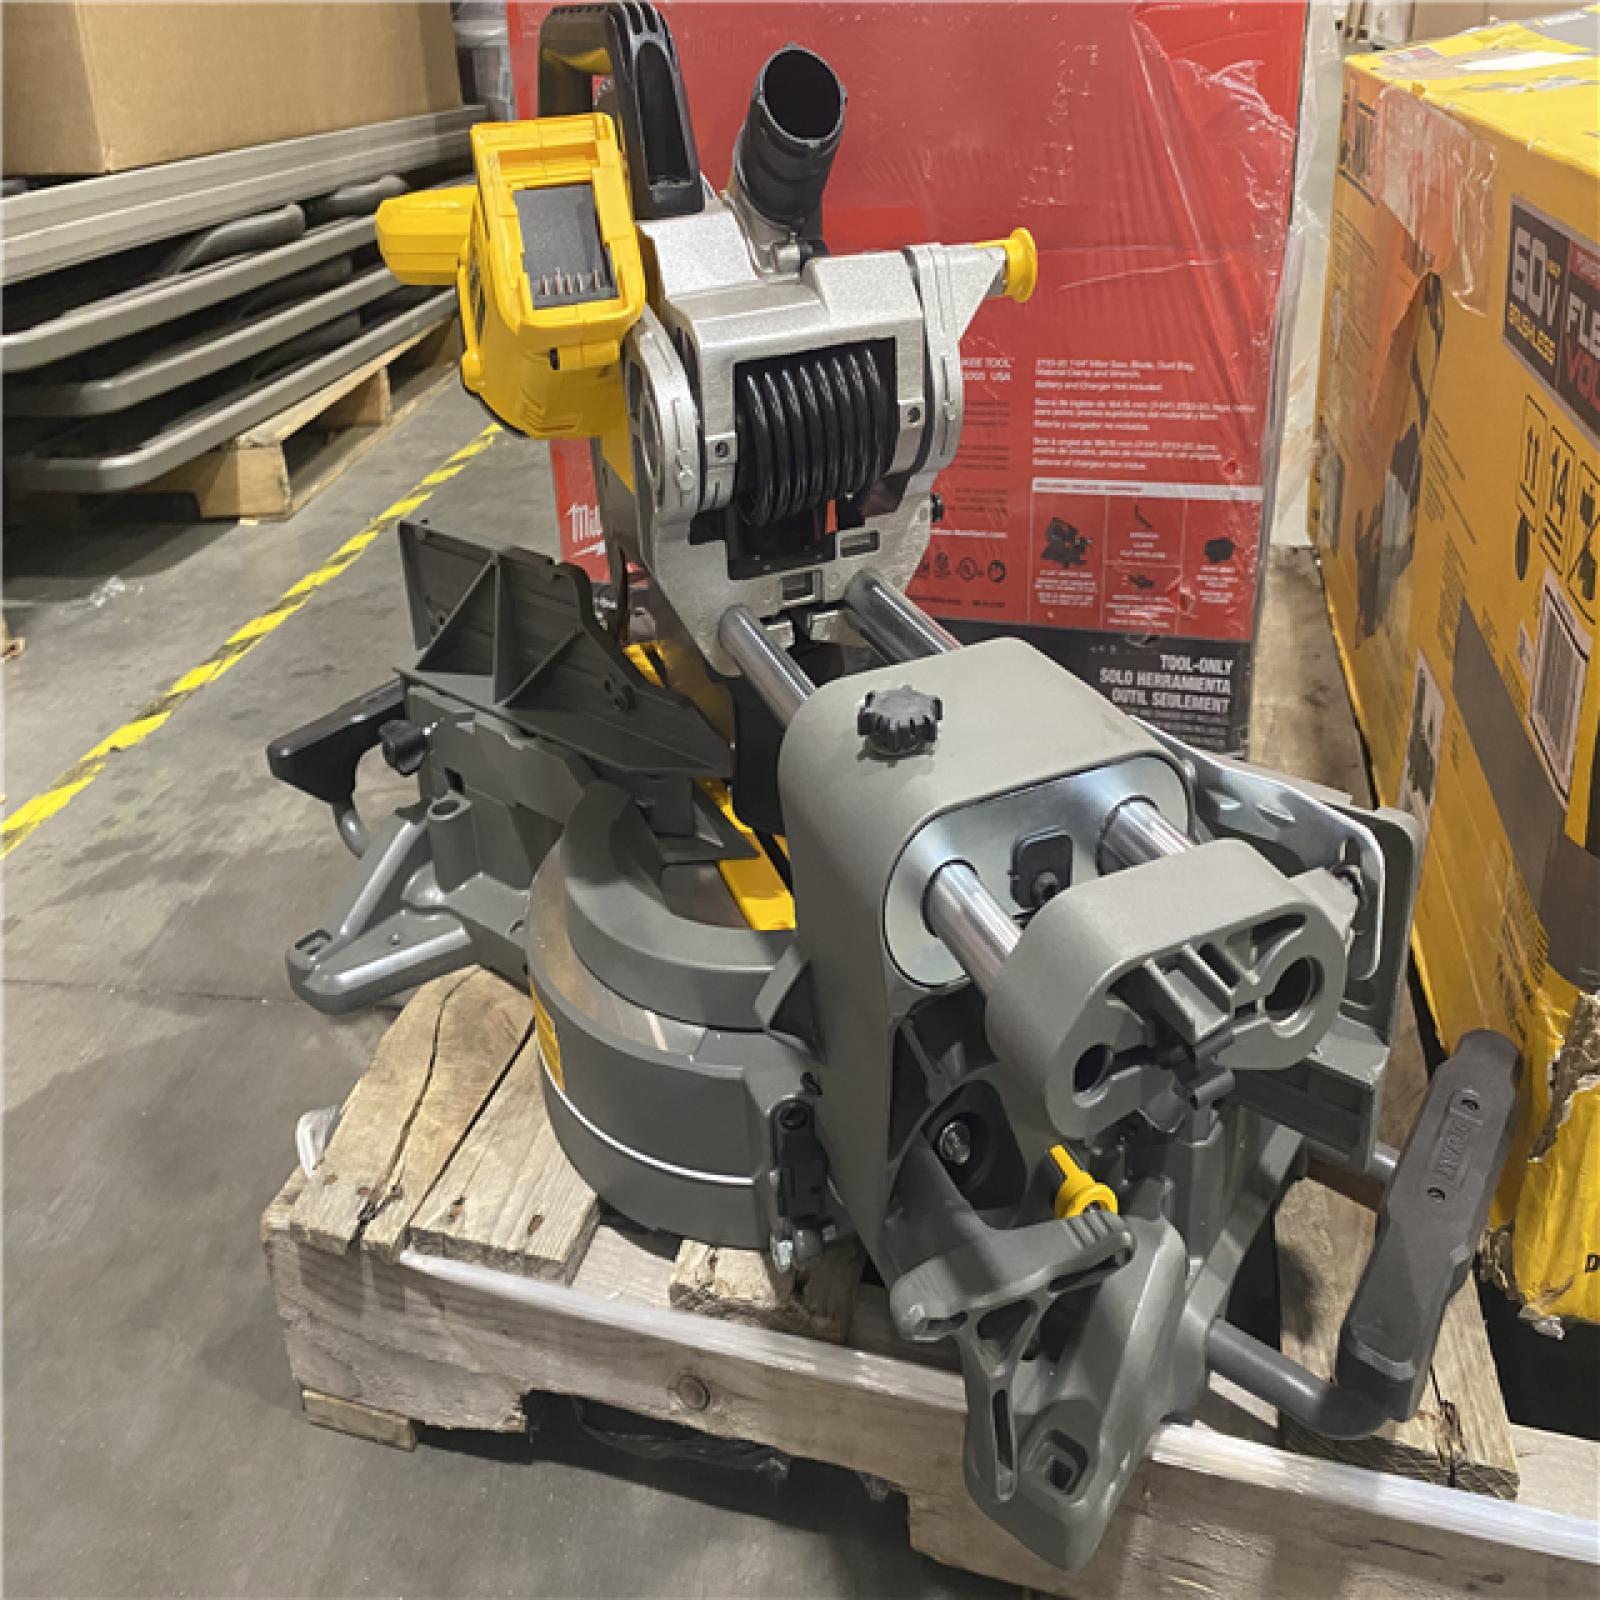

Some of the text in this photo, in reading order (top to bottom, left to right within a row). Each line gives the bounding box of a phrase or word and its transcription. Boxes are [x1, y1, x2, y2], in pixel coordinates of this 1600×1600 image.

[1566, 291, 1600, 362] FLE
[1160, 654, 1233, 676] TOOL-ONLY
[1100, 667, 1231, 694] SOLO HERRAMIENTA
